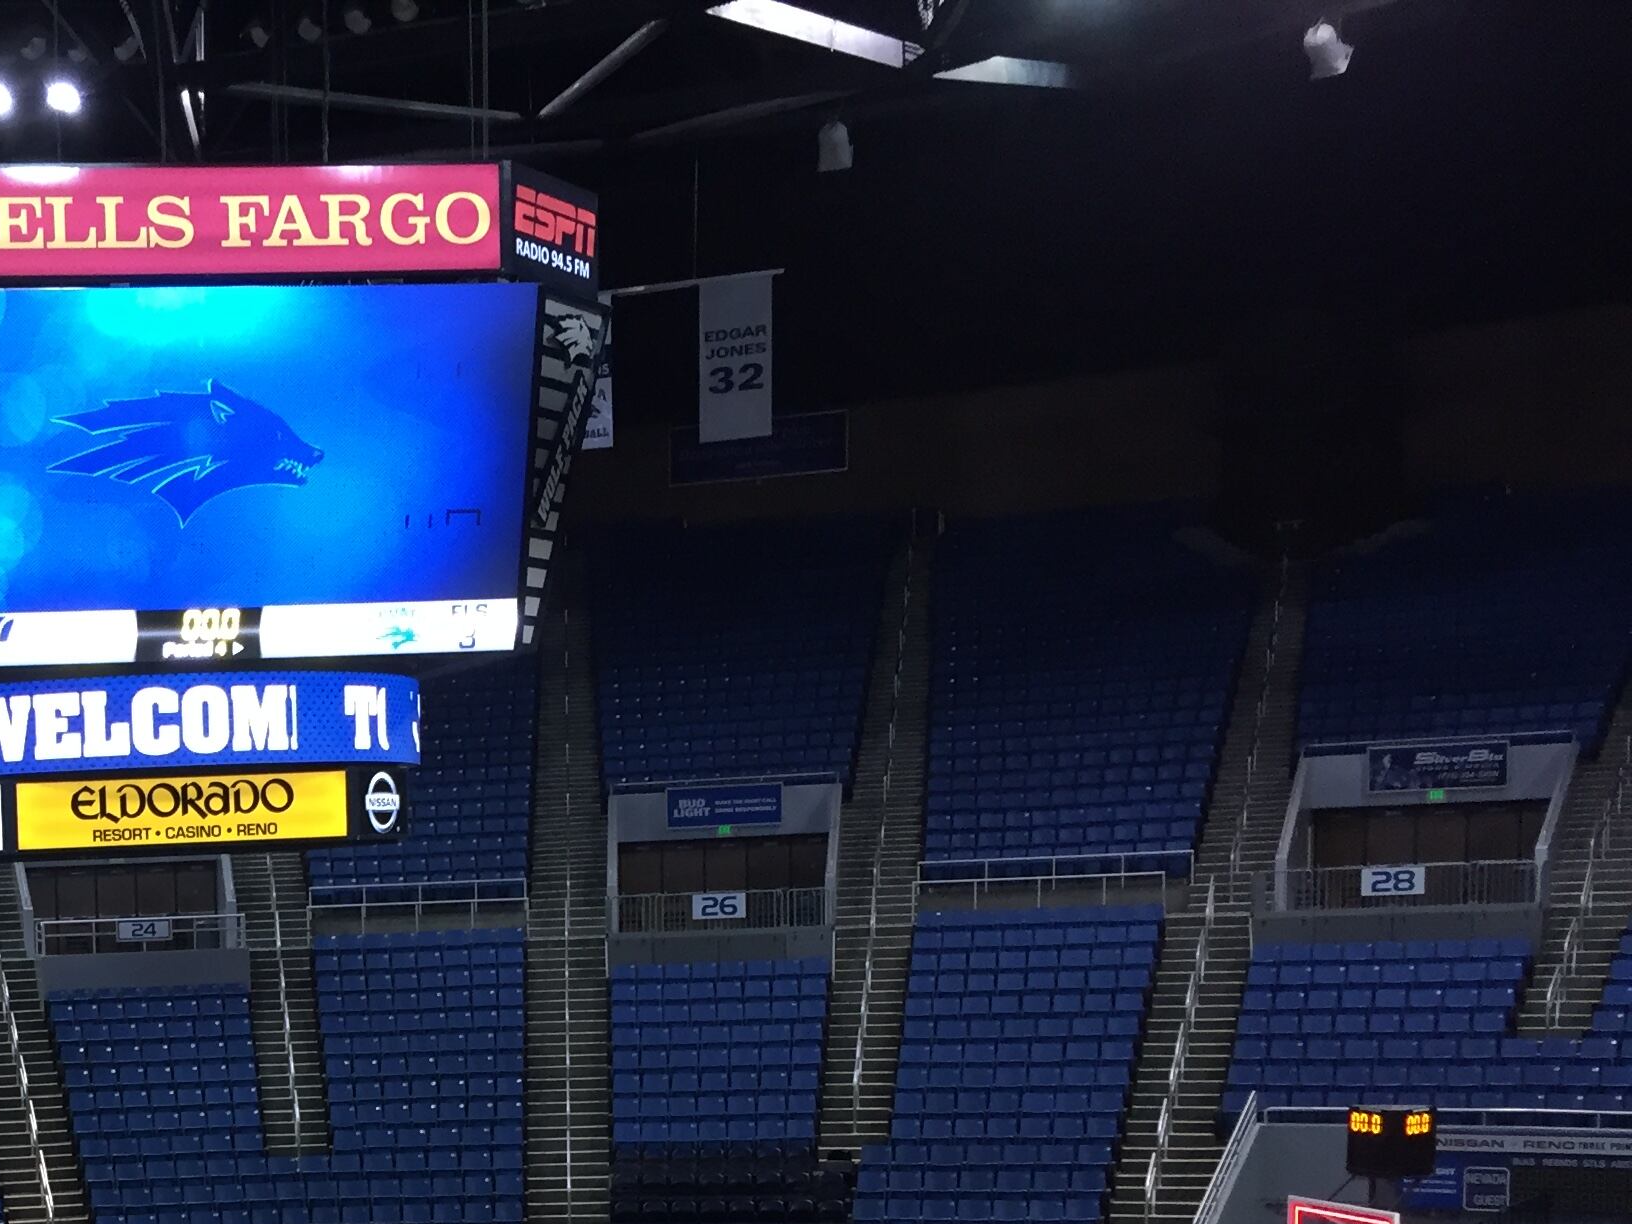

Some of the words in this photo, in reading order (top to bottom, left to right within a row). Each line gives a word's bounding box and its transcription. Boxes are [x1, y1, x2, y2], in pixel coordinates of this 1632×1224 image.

[220, 191, 491, 248] FARGO
[514, 184, 596, 258] ESPN
[516, 238, 549, 264] RADIO
[551, 250, 572, 273] 94.5
[574, 258, 590, 279] FM
[704, 324, 767, 342] EDGAR
[705, 342, 766, 360] JONES
[708, 363, 764, 394] 32
[70, 778, 294, 824] ELDORADO
[368, 797, 397, 807] NISSAN
[679, 798, 706, 809] BUD
[673, 807, 711, 818] LIGHT
[93, 827, 151, 842] RESORT
[165, 824, 221, 839] CASINO
[237, 822, 278, 836] RENO
[1371, 870, 1416, 893] 28
[701, 896, 738, 916] 26
[131, 922, 157, 937] 24
[1437, 1137, 1505, 1149] NISSAN
[1523, 1140, 1575, 1151] RENO
